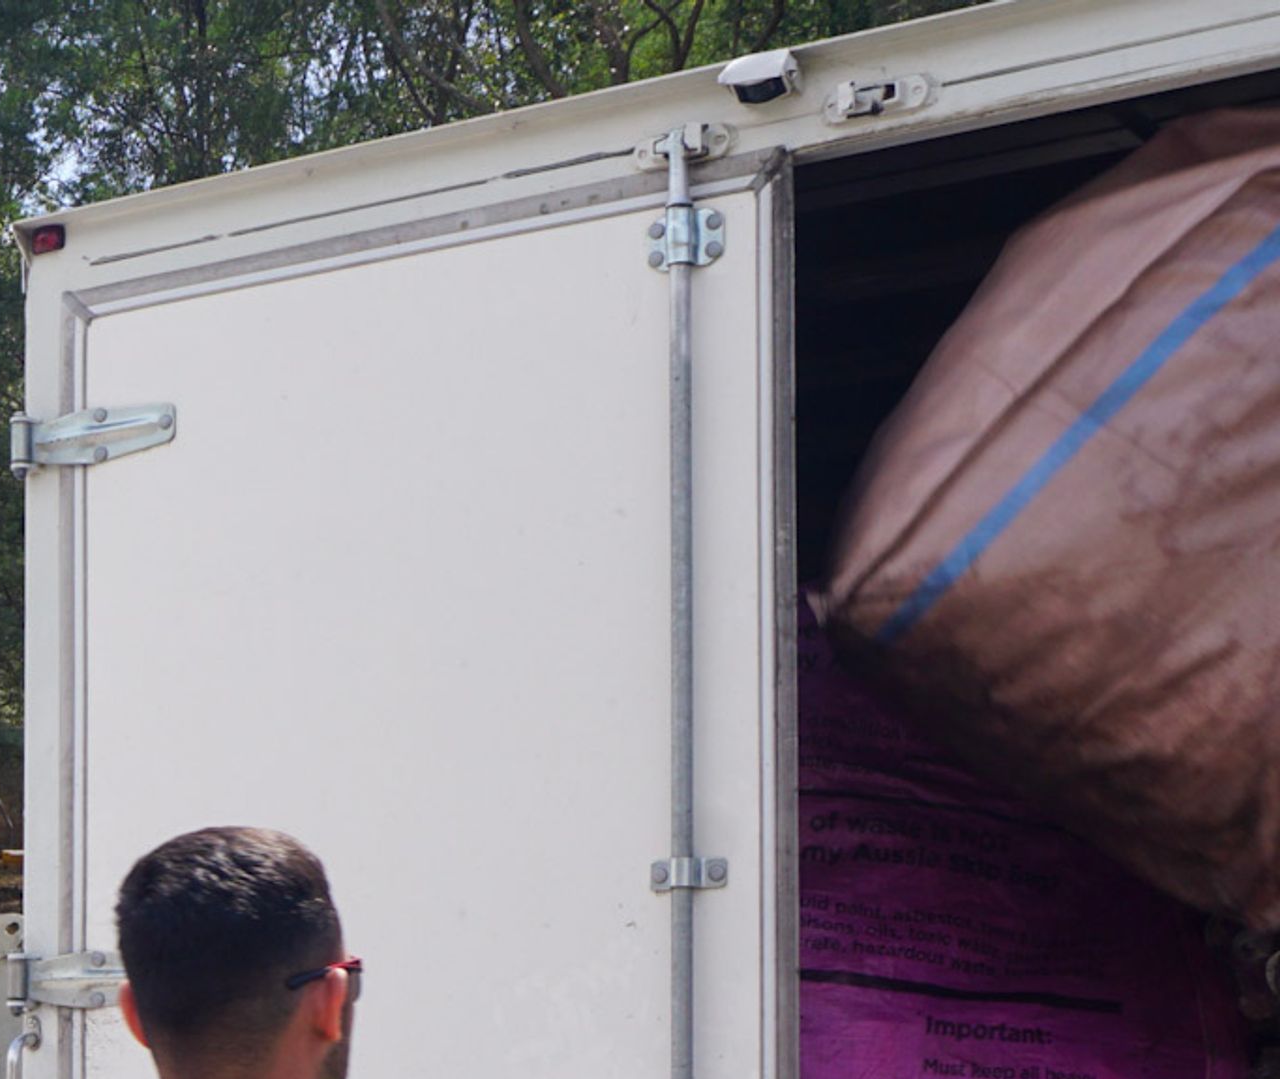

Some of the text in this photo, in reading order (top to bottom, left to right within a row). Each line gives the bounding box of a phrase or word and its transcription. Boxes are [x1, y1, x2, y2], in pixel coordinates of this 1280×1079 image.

[810, 811, 839, 832] of
[851, 842, 941, 869] Aussie
[854, 941, 945, 965] hazardous
[925, 1015, 1054, 1045] Important:
[923, 1058, 966, 1078] Must
[1020, 1066, 1040, 1079] all
